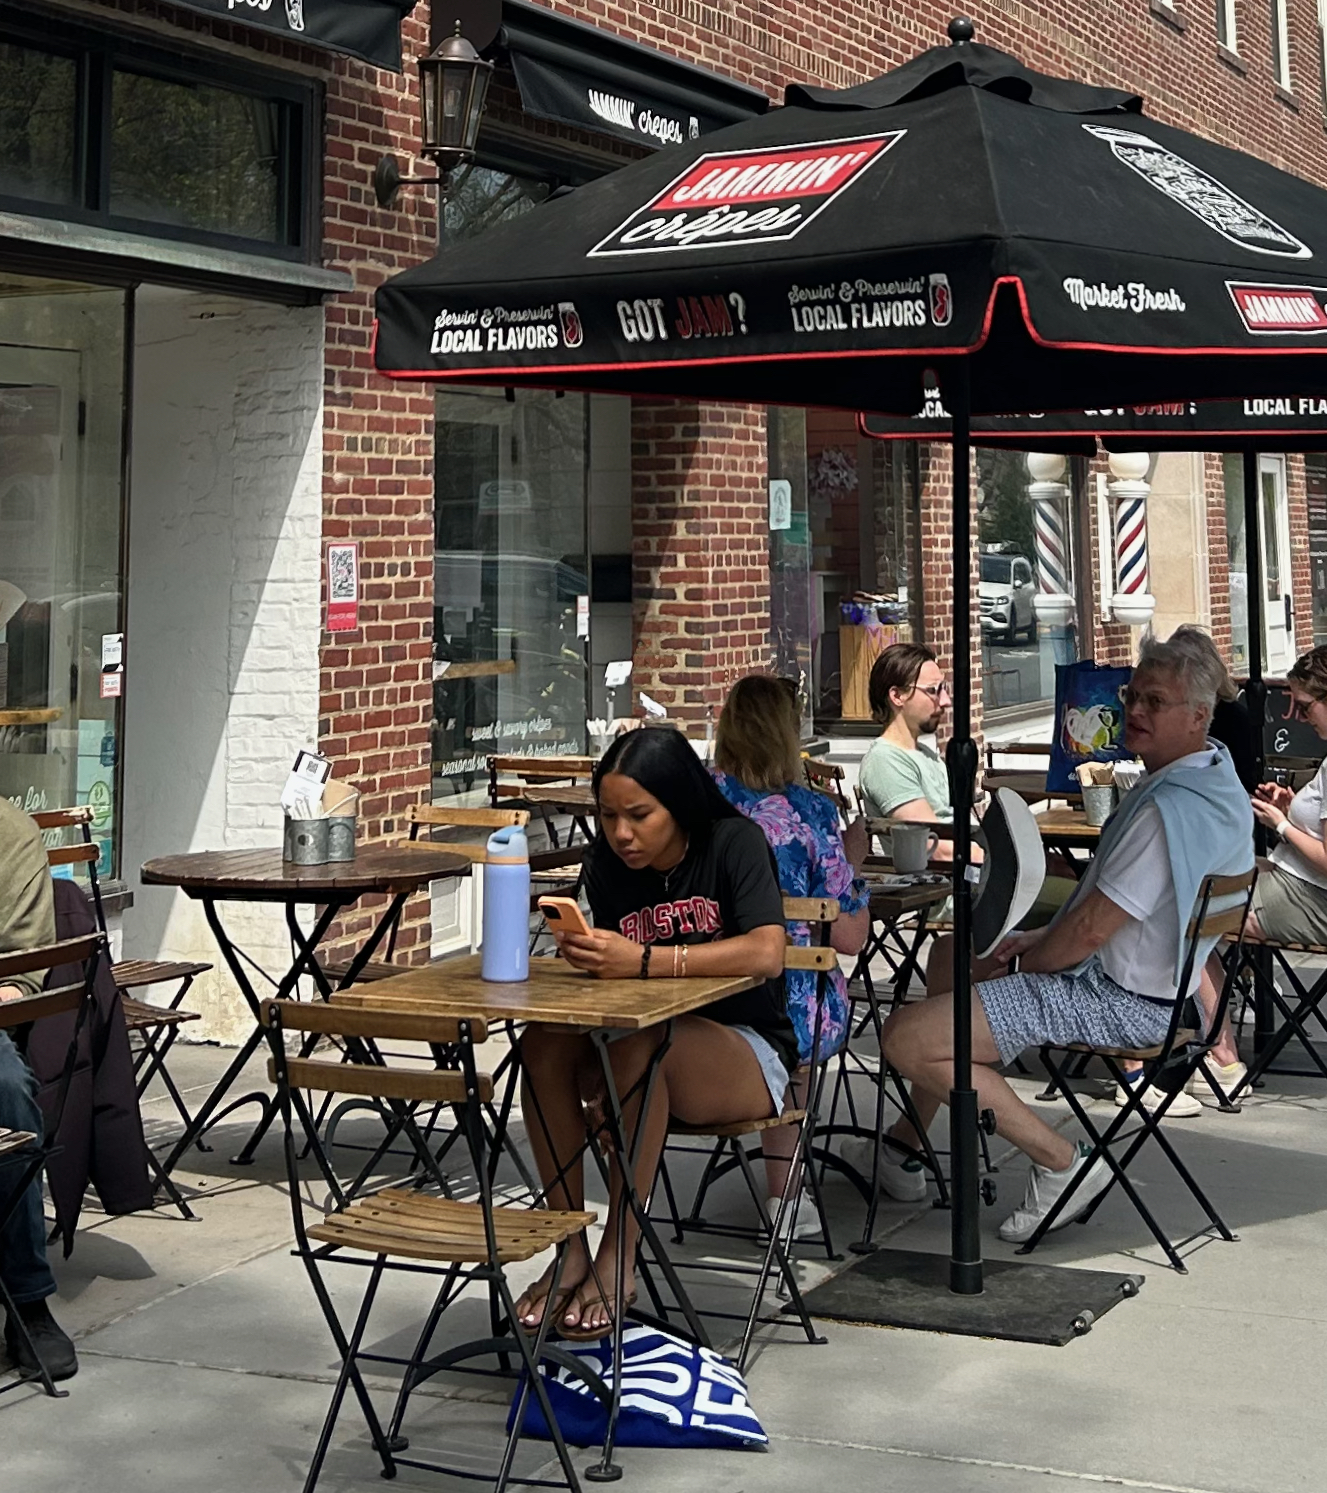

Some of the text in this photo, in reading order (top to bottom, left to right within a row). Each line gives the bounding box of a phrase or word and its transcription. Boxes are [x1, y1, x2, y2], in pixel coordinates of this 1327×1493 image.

[672, 151, 868, 203] JAMMIN'
[620, 204, 802, 245] crêpes
[788, 276, 924, 305] Servin' & Preservin'
[1063, 277, 1185, 313] Market Fresh
[434, 305, 554, 330] Servin' & Preservin'
[616, 298, 669, 343] GOT
[791, 299, 926, 332] LOCAL FLAVORS
[1243, 294, 1320, 324] JAMMIN'
[430, 324, 559, 354] LOCAL FLAVORS
[1243, 397, 1295, 416] LOCAL
[619, 896, 724, 944] BOSTON
